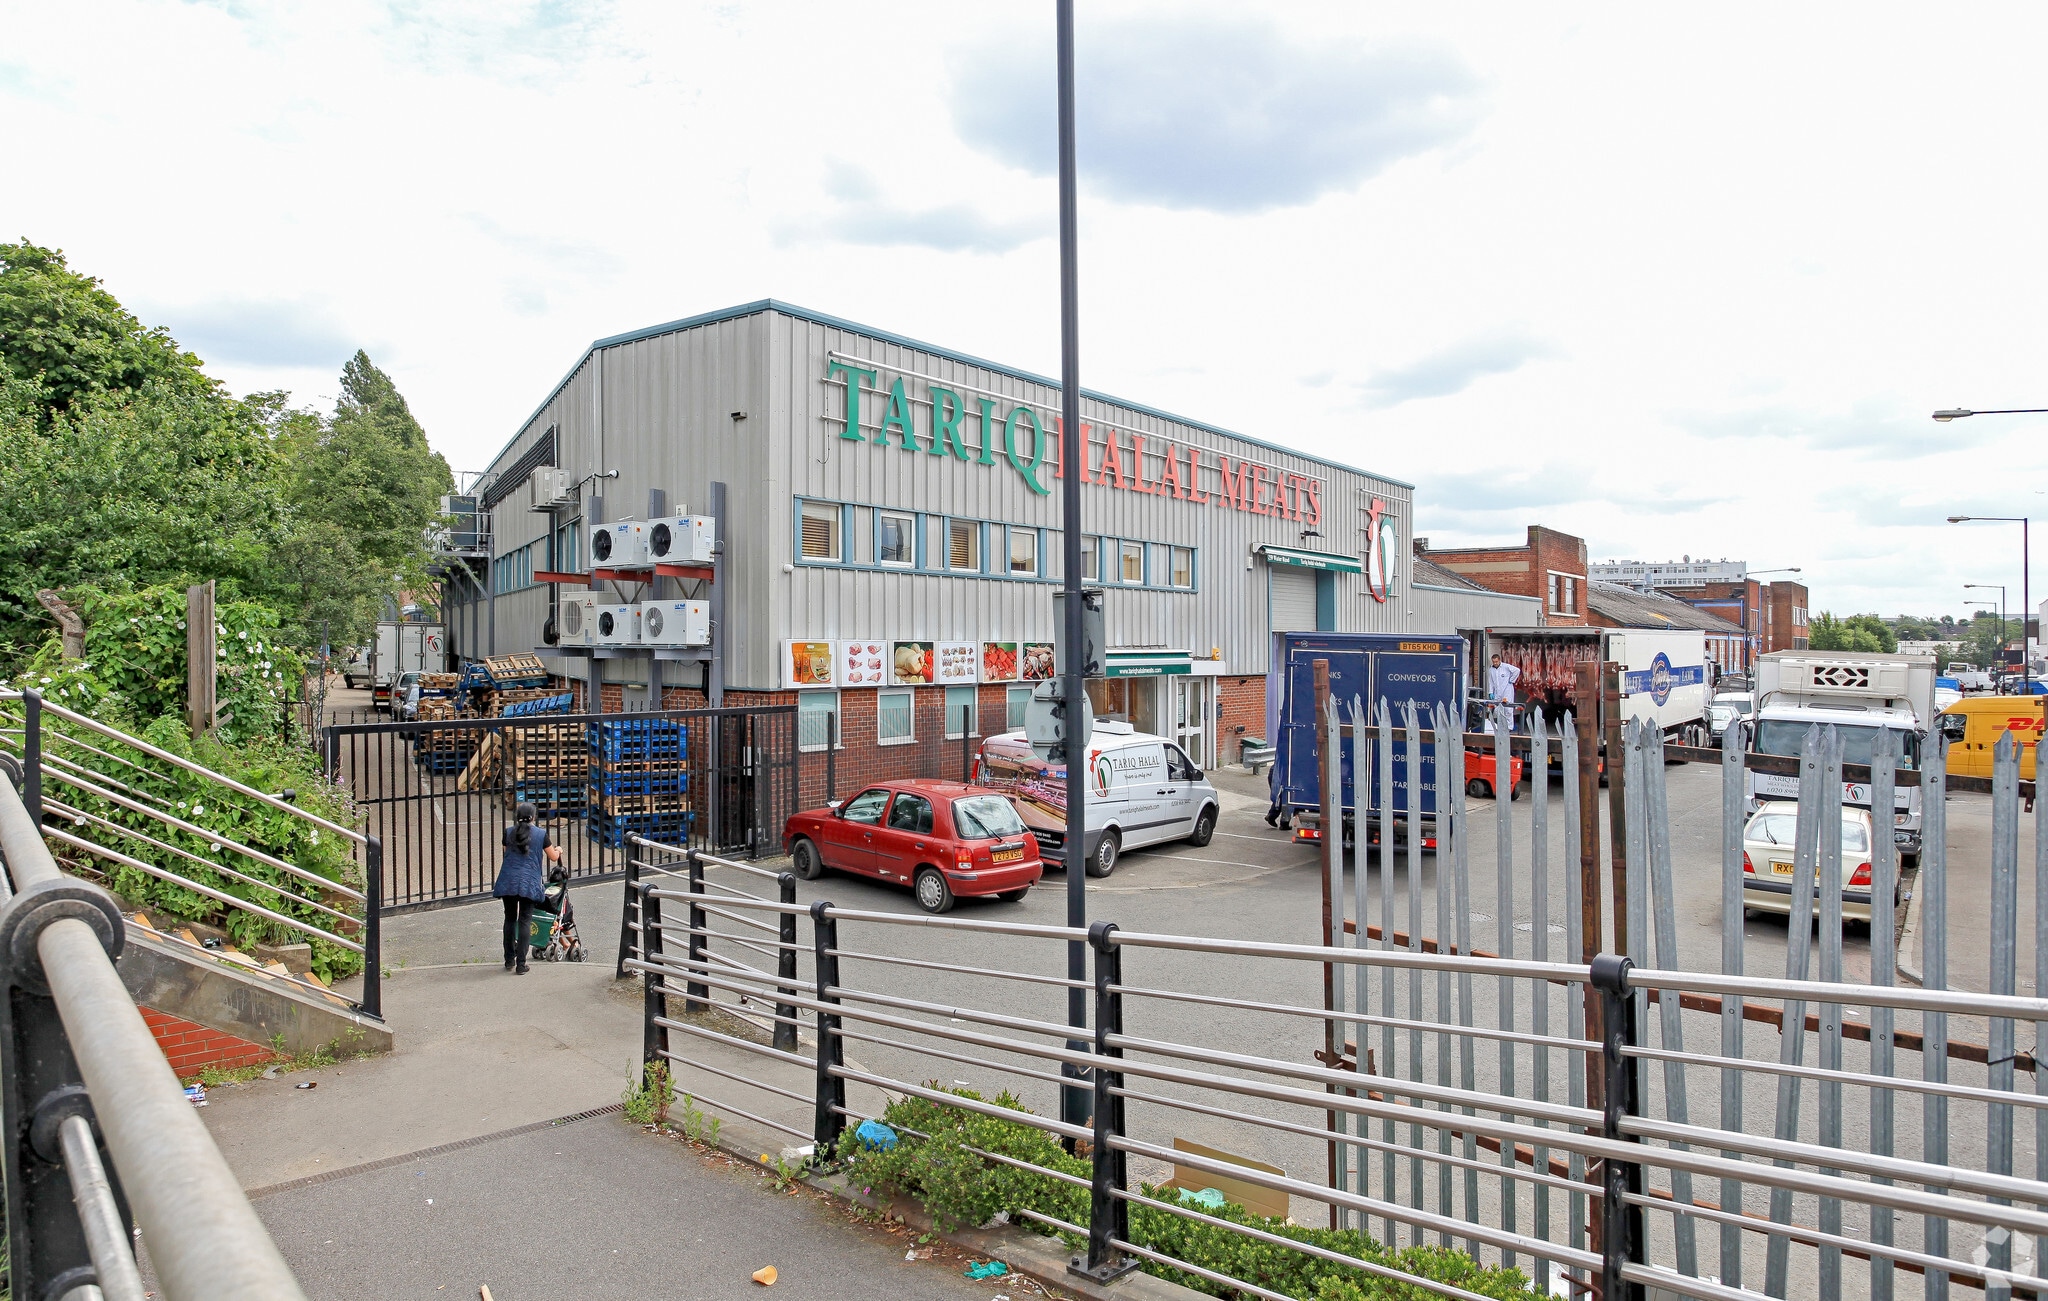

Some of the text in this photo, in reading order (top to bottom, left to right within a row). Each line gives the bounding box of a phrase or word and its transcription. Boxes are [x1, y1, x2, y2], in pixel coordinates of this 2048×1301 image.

[828, 360, 1322, 526] TARIQ HALAL MEATS
[1387, 673, 1437, 683] CONVEYORS
[1112, 756, 1160, 769] TARIQ HALAL
[1768, 776, 1791, 784] TARIQ
[993, 851, 1010, 861] T273
